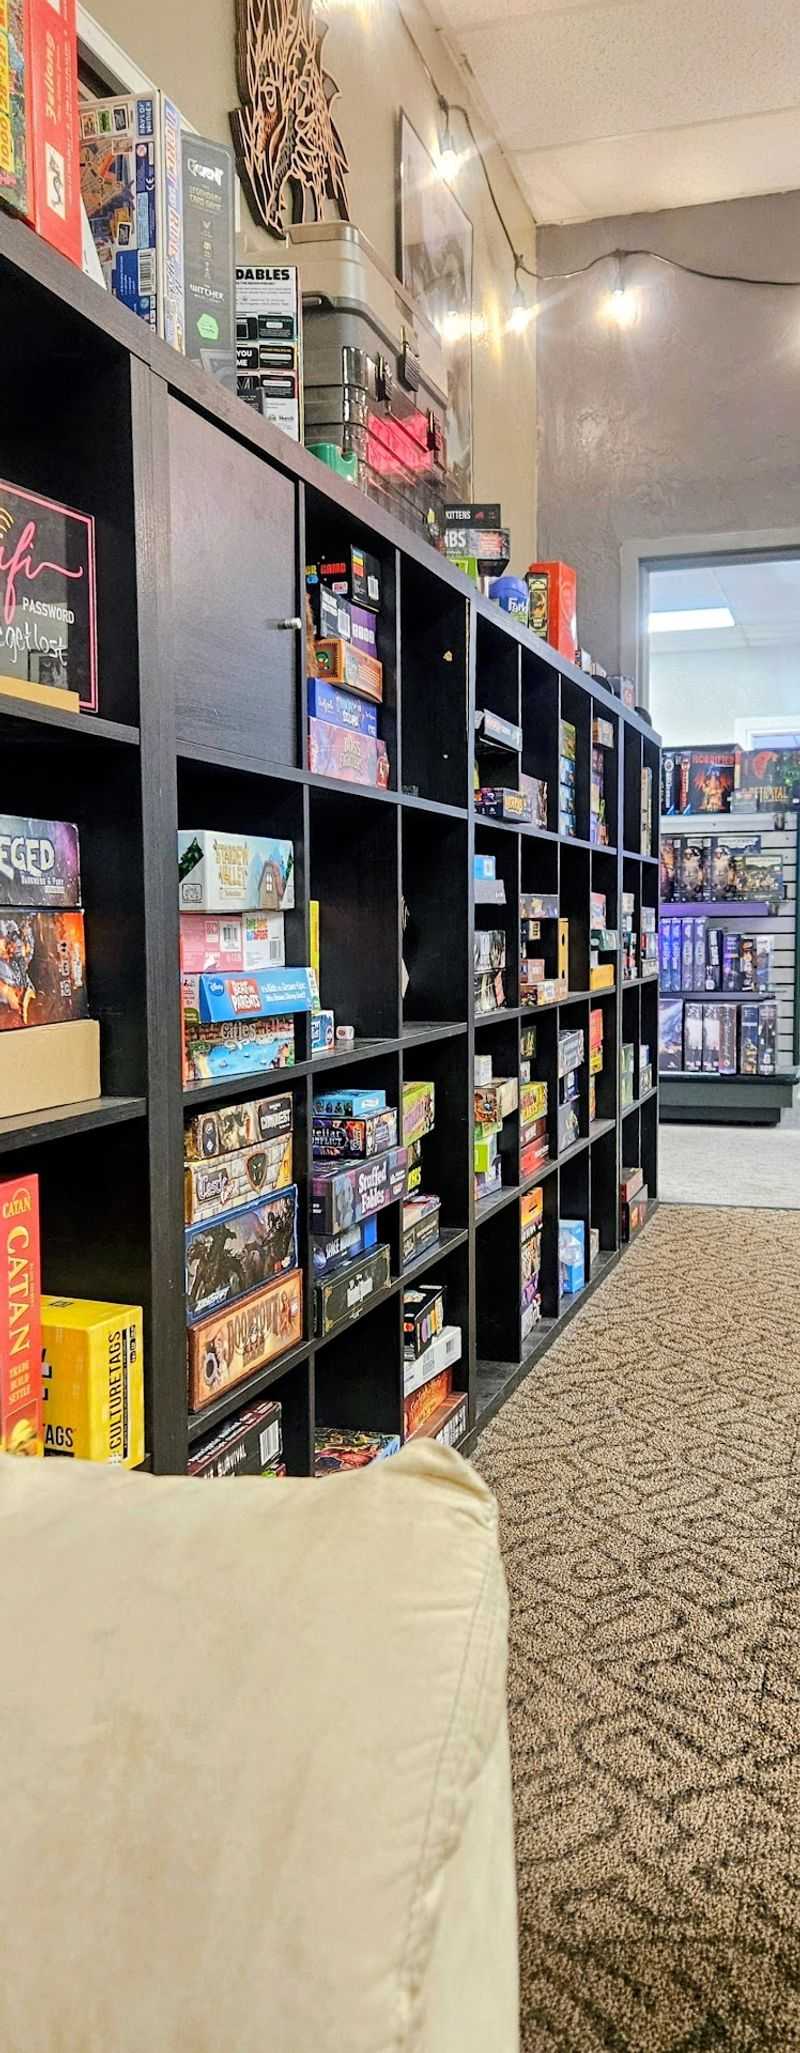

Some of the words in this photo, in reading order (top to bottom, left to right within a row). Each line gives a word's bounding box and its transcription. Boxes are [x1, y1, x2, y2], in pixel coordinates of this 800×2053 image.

[22, 597, 75, 624] PASSWORD
[312, 1128, 340, 1137] tellar
[358, 1161, 387, 1194] Stuffed
[2, 1195, 32, 1219] CATAN
[6, 1225, 31, 1355] CATAN
[109, 1330, 122, 1452] CULTURETAGS
[45, 1424, 74, 1448] AGS
